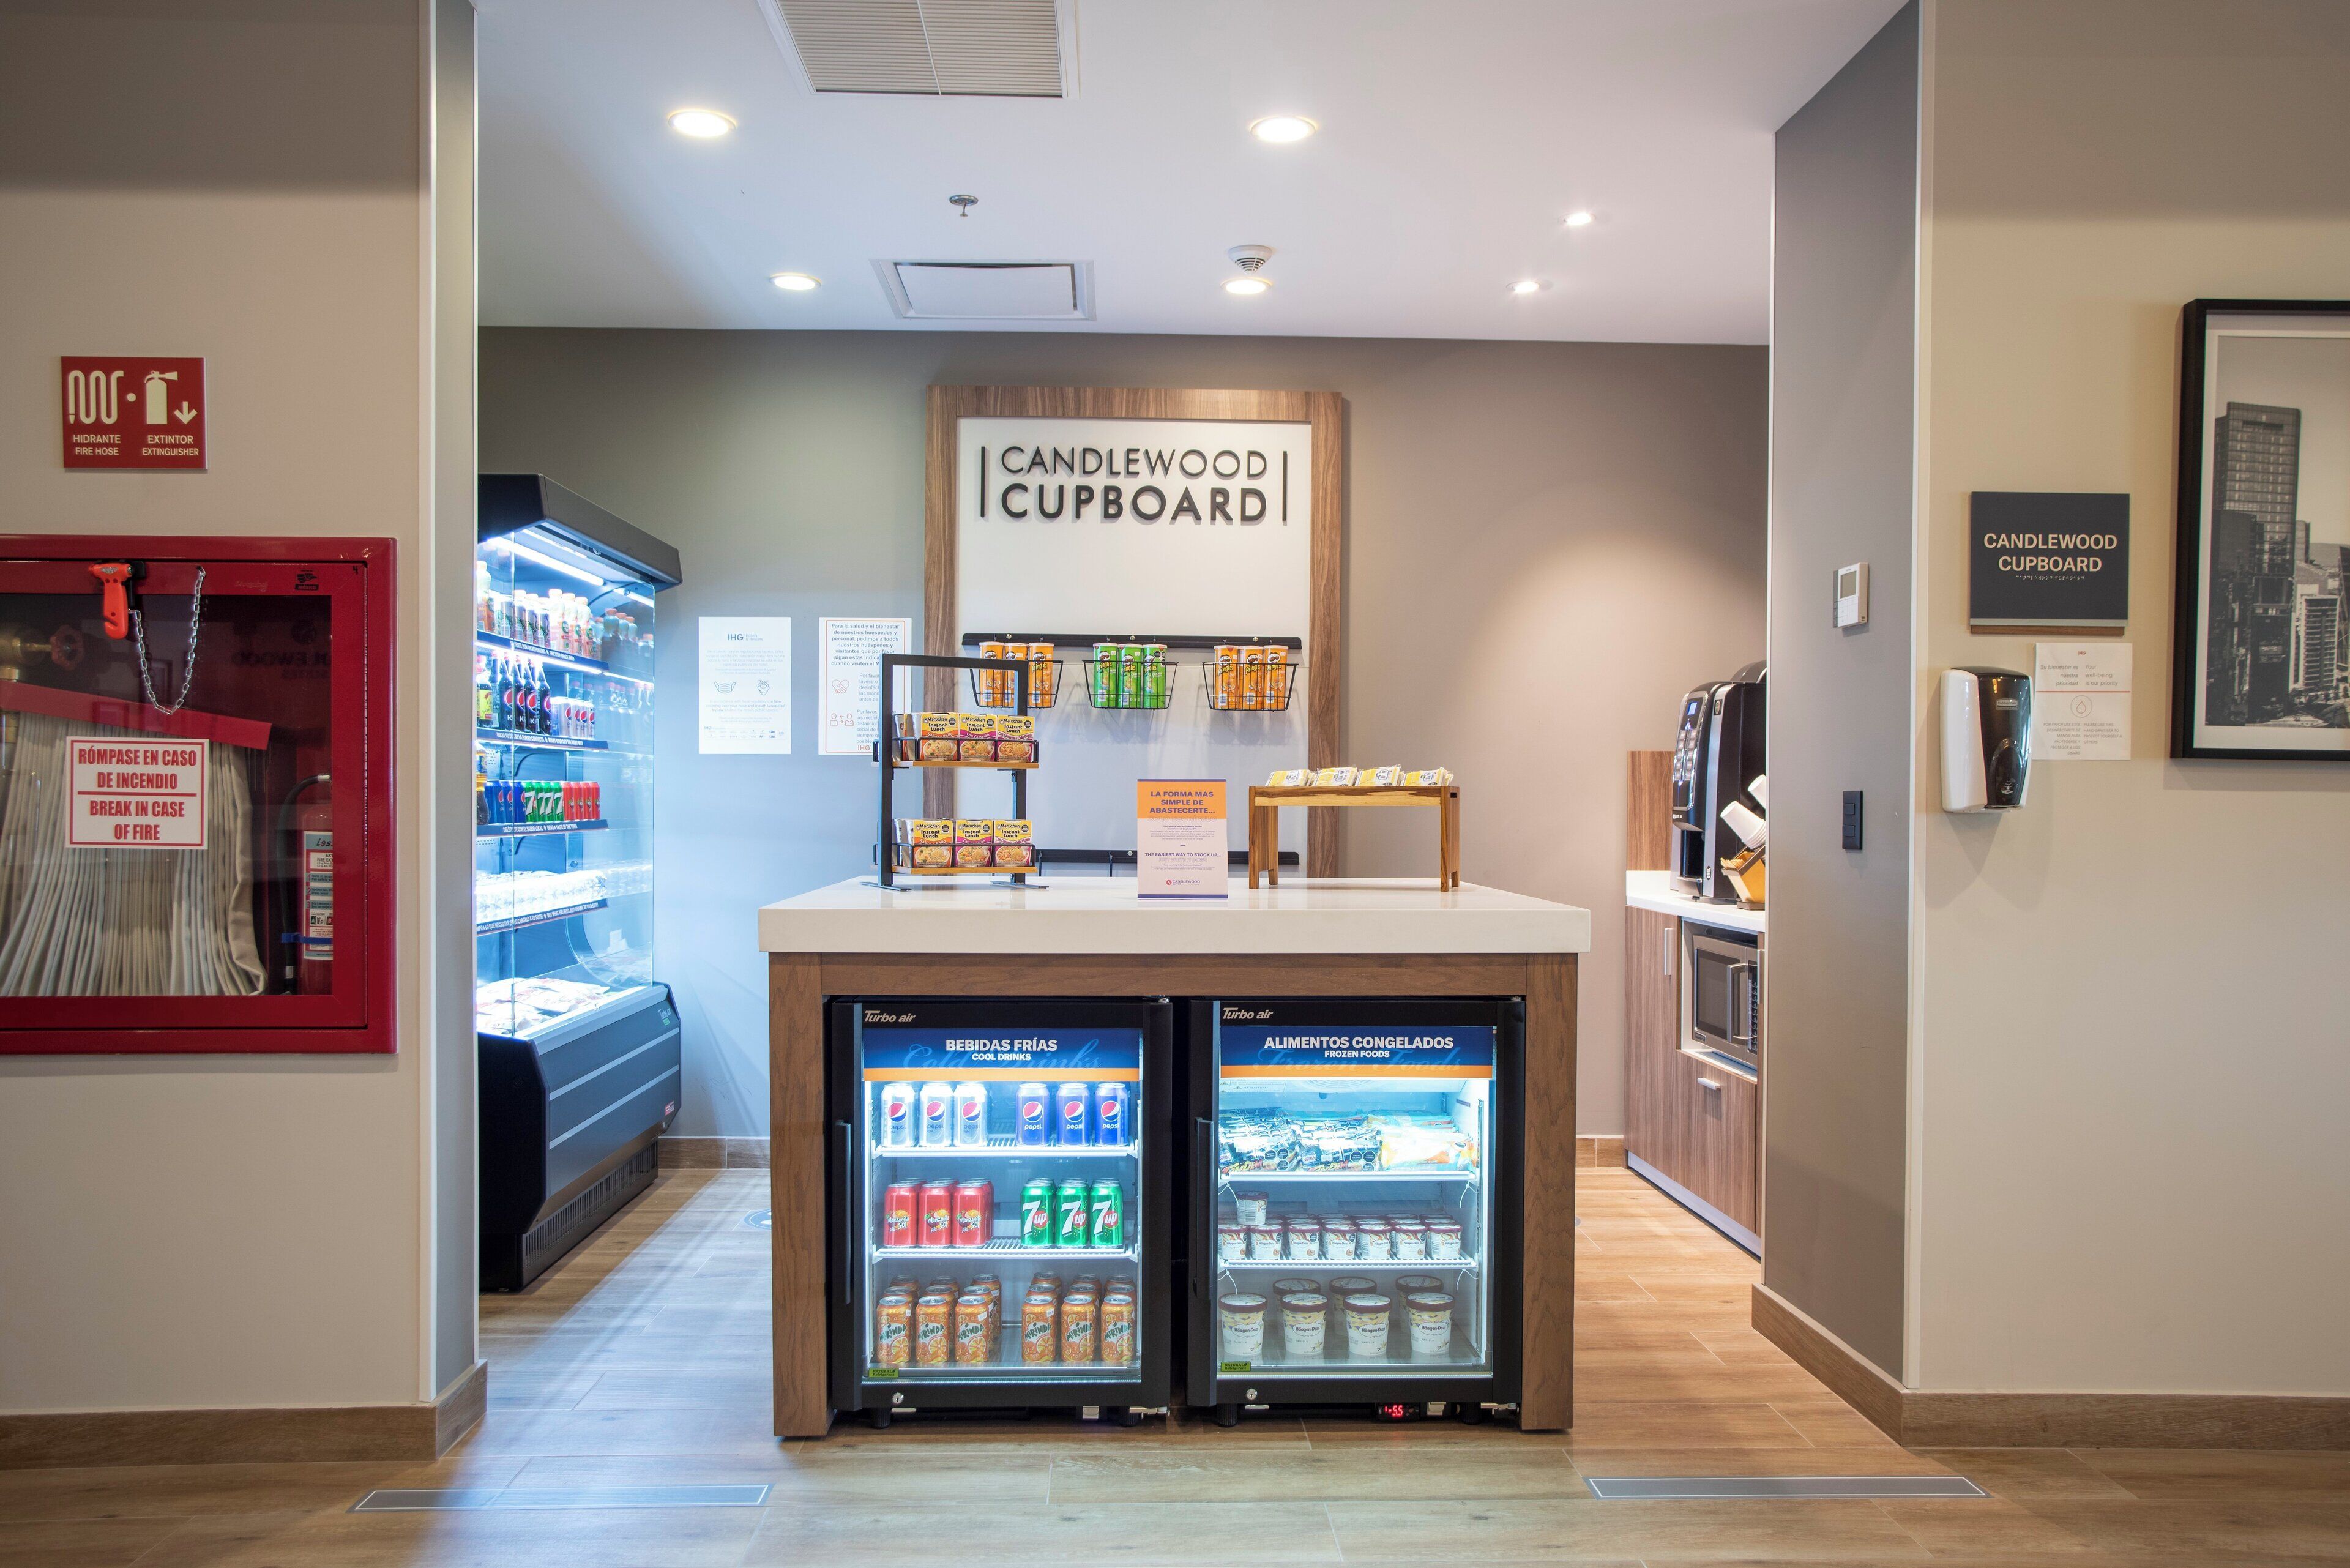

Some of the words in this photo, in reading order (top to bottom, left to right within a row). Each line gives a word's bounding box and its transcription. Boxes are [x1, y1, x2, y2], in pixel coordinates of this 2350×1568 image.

[73, 435, 121, 444] HIDRANTE
[147, 435, 193, 444] EXTINTOR
[1001, 446, 1267, 477] CANDLEWOOD
[1001, 483, 1266, 521] CUPBOARD
[1983, 533, 2117, 550] CANDLEWOOD
[1998, 556, 2102, 572] CUPBOARD
[78, 745, 140, 765] RÓMPASE
[143, 750, 159, 765] EN
[162, 750, 197, 766] CASO
[97, 772, 113, 788] DE
[116, 772, 178, 790] INCENDIO
[89, 800, 132, 816] BREAK
[135, 801, 149, 816] IN
[152, 801, 185, 817] CASE
[114, 824, 130, 840] OF
[133, 824, 160, 840] FIRE
[864, 1010, 896, 1023] Turbo
[898, 1013, 916, 1023] air
[1223, 1007, 1255, 1020] Turbo
[1256, 1010, 1273, 1020] air
[946, 1039, 1010, 1051] BEBIDAS
[1014, 1037, 1058, 1051] FRÍAS
[1264, 1037, 1349, 1048] ALIMENTOS
[1352, 1037, 1453, 1048] CONGELADOS
